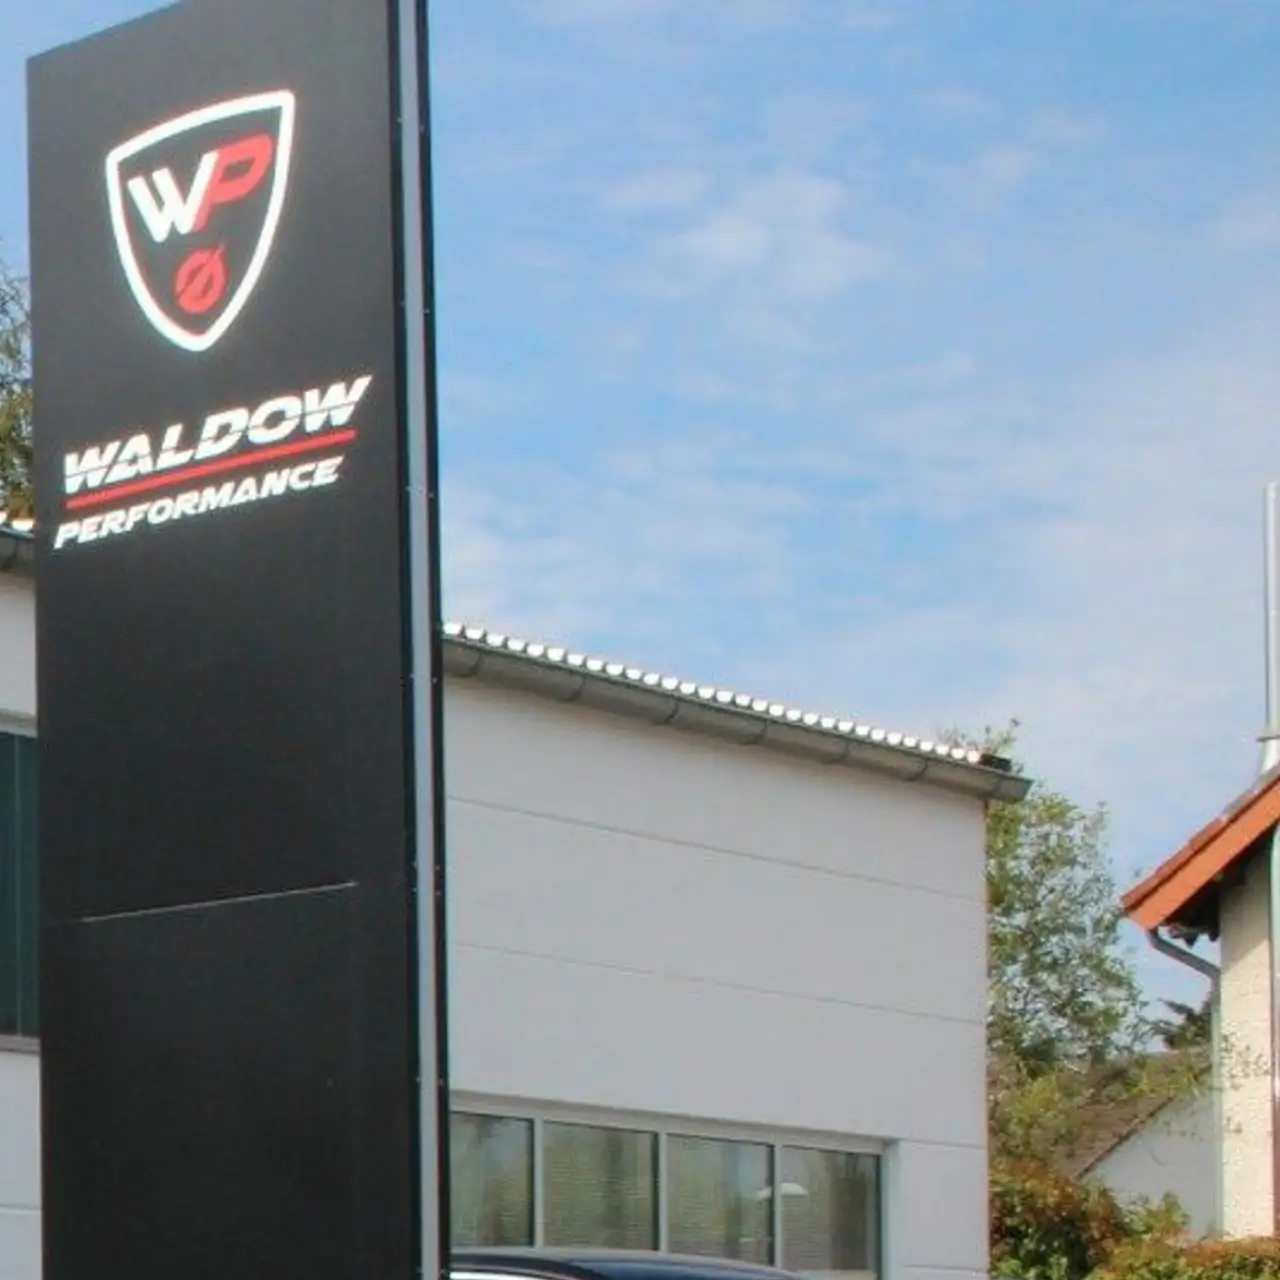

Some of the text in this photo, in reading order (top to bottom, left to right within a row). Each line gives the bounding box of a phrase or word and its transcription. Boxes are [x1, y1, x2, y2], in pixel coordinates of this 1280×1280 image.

[127, 133, 276, 243] WP
[64, 376, 372, 494] WALDOW
[53, 456, 345, 549] PERFORMANCE
